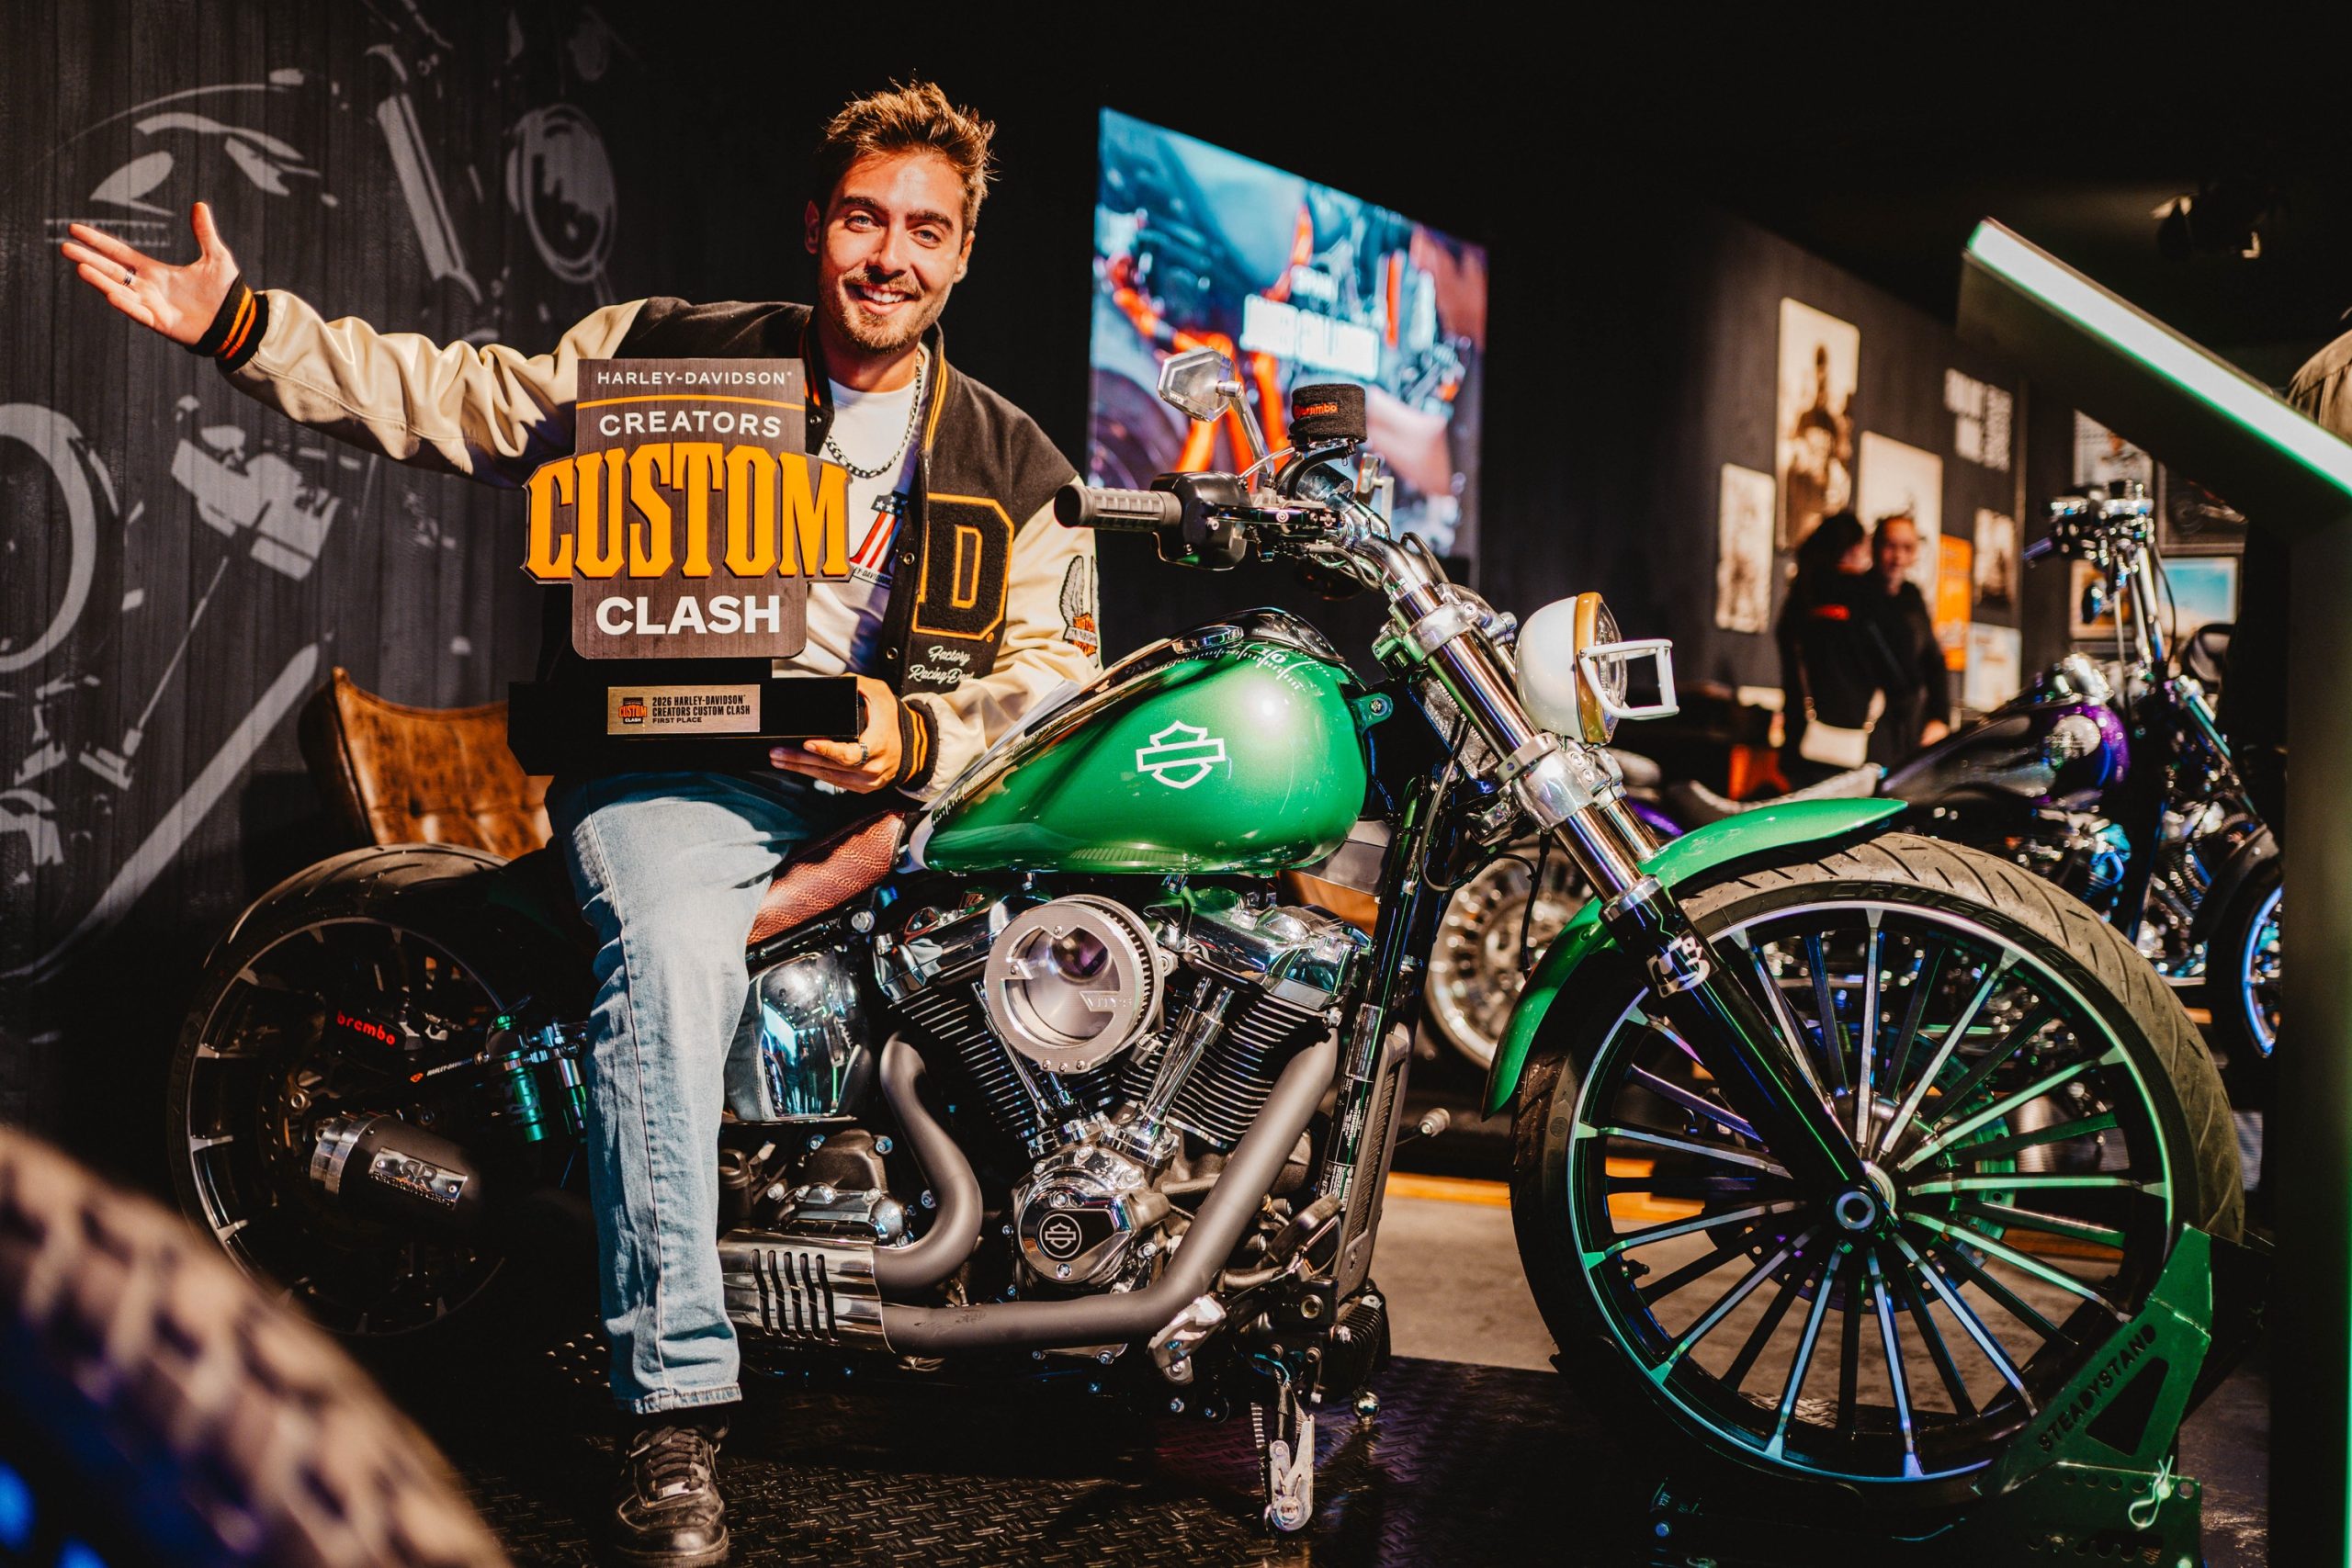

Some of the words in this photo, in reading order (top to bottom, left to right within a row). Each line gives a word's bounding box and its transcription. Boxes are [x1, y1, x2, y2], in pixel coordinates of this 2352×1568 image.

[599, 411, 781, 438] CREATORS
[526, 442, 852, 580] CUSTOM
[595, 595, 780, 635] CLASH
[928, 645, 971, 667] Factory
[908, 664, 948, 684] Racing
[652, 696, 672, 706] 2026
[673, 694, 743, 706] HARLEY-DAVIDSON
[652, 706, 691, 716] CREATORS
[693, 705, 724, 716] CUSTOM
[726, 705, 751, 715] CLASH
[336, 1011, 396, 1045] brembo
[2038, 1324, 2156, 1452] STEADYSTAND
